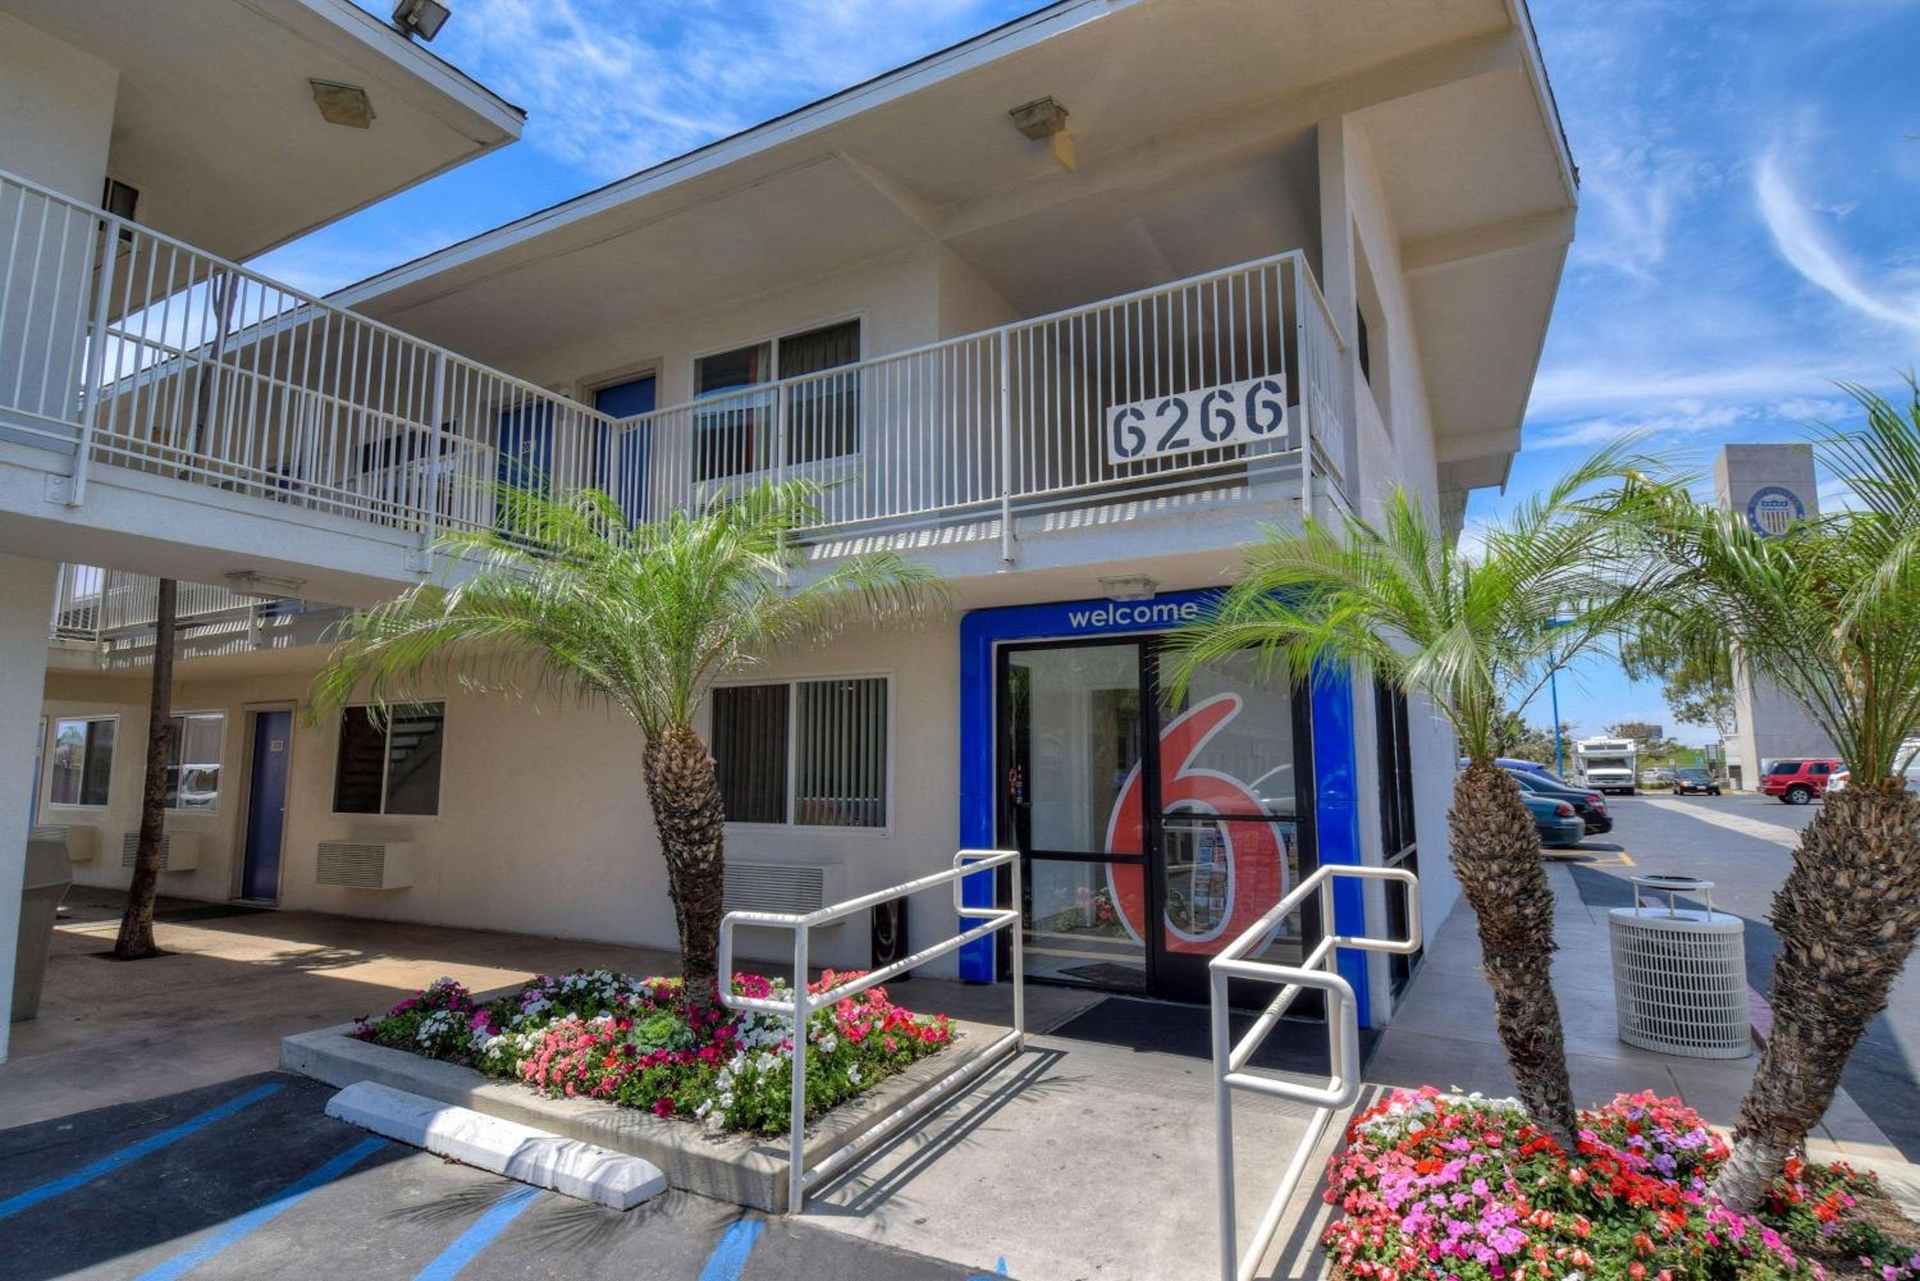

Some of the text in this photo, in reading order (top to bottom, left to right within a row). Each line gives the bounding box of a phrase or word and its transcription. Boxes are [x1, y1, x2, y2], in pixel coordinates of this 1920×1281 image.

[1113, 380, 1283, 458] 6266
[1068, 602, 1199, 628] welcome
[1105, 692, 1290, 959] 6
